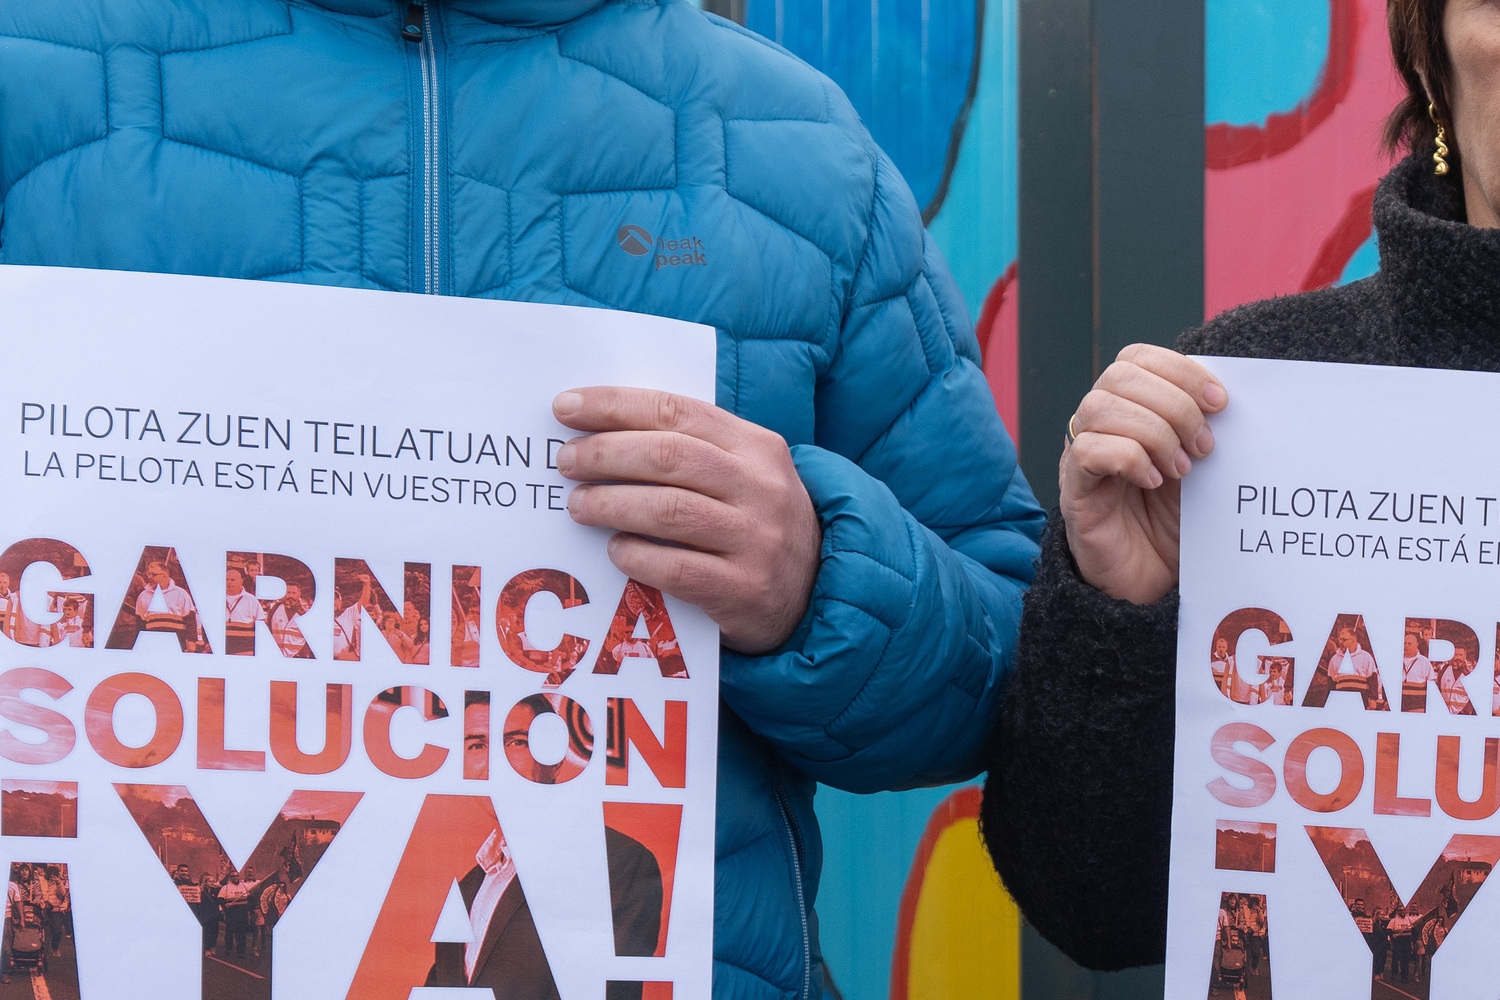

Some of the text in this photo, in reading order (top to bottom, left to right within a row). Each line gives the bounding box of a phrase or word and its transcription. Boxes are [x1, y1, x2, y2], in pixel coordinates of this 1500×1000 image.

[655, 250, 707, 270] peak
[20, 402, 165, 443] PILOTA
[177, 410, 292, 451] ZUEN
[304, 421, 531, 468] TEILATUAN
[23, 451, 65, 479] LA
[75, 454, 205, 486] PELOTA
[214, 460, 299, 493] ESTÁ
[310, 468, 354, 497] EN
[363, 472, 518, 507] VUESTRO
[1237, 485, 1360, 521] PILOTA
[1368, 491, 1464, 525] ZUEN
[1239, 529, 1275, 554] LA
[1283, 531, 1389, 560] PELOTA
[1398, 534, 1469, 564] ESTÁ
[0, 537, 691, 680] GARNICA
[0, 667, 687, 788] SOLUCIÓN
